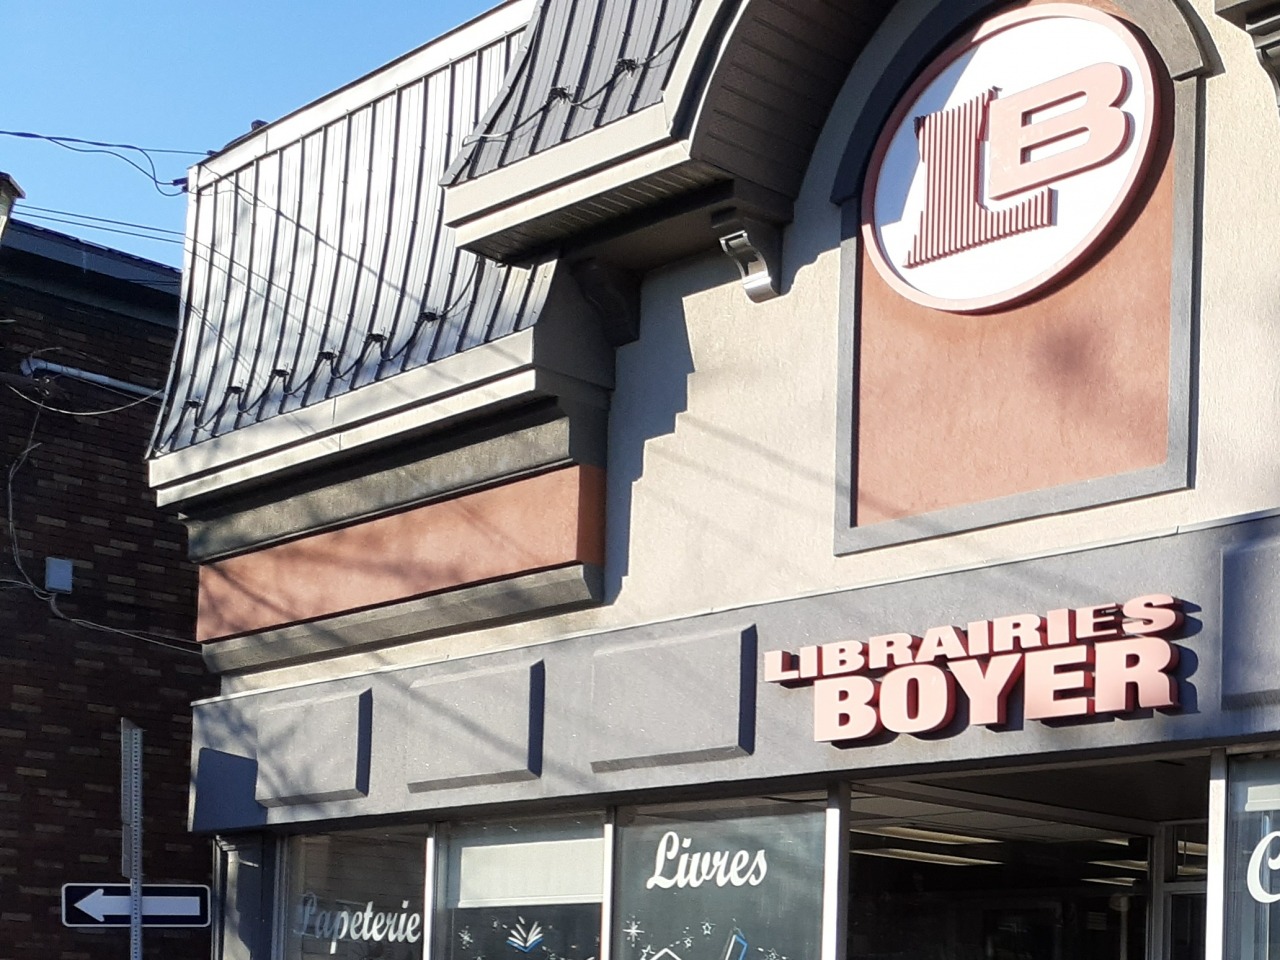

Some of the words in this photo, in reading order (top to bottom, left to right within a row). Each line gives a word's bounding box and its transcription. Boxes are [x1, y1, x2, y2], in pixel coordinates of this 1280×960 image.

[764, 594, 1183, 688] LIBRAIRIES
[813, 636, 1180, 743] BOYER
[645, 831, 769, 890] Livres
[293, 889, 421, 955] Papeterie
